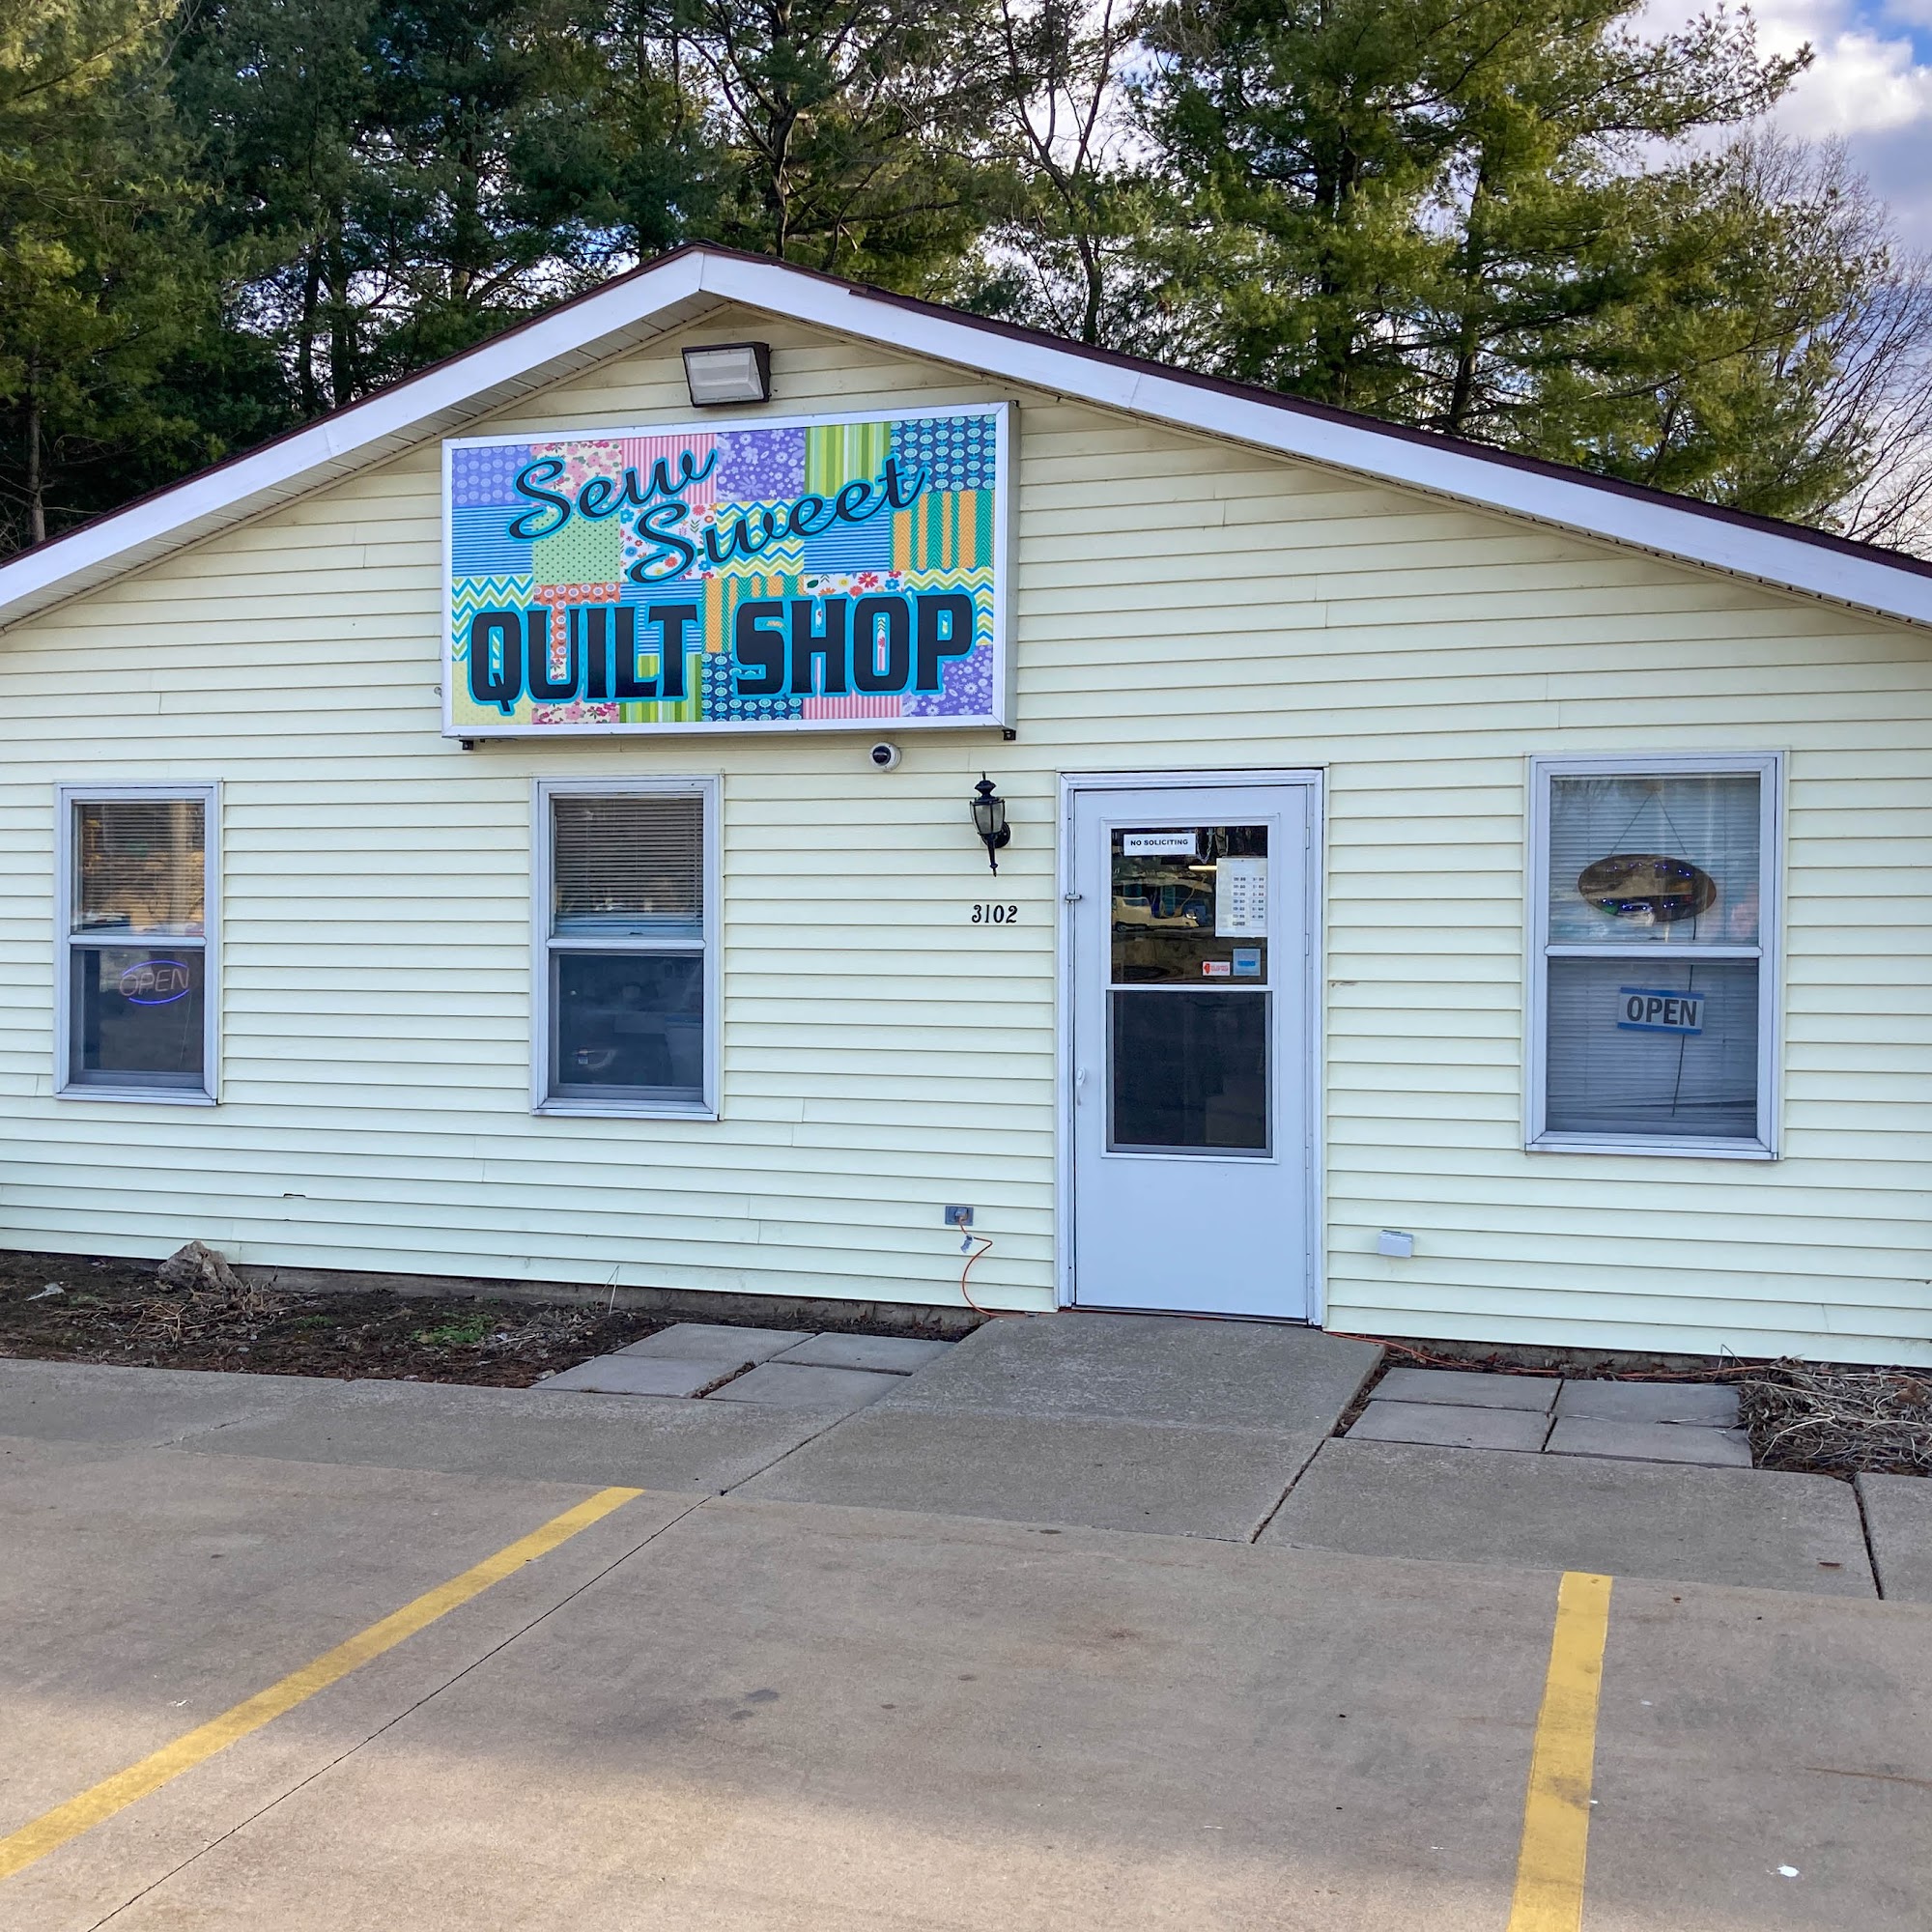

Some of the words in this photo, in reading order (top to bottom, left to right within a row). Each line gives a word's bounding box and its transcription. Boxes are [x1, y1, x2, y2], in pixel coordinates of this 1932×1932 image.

[508, 448, 717, 541] Sew
[629, 455, 929, 583] Sweet
[469, 602, 699, 715] QUILT
[734, 591, 975, 698] SHOP
[971, 904, 1018, 923] 3102
[119, 967, 189, 997] OPEN
[1626, 995, 1697, 1027] OPEN
